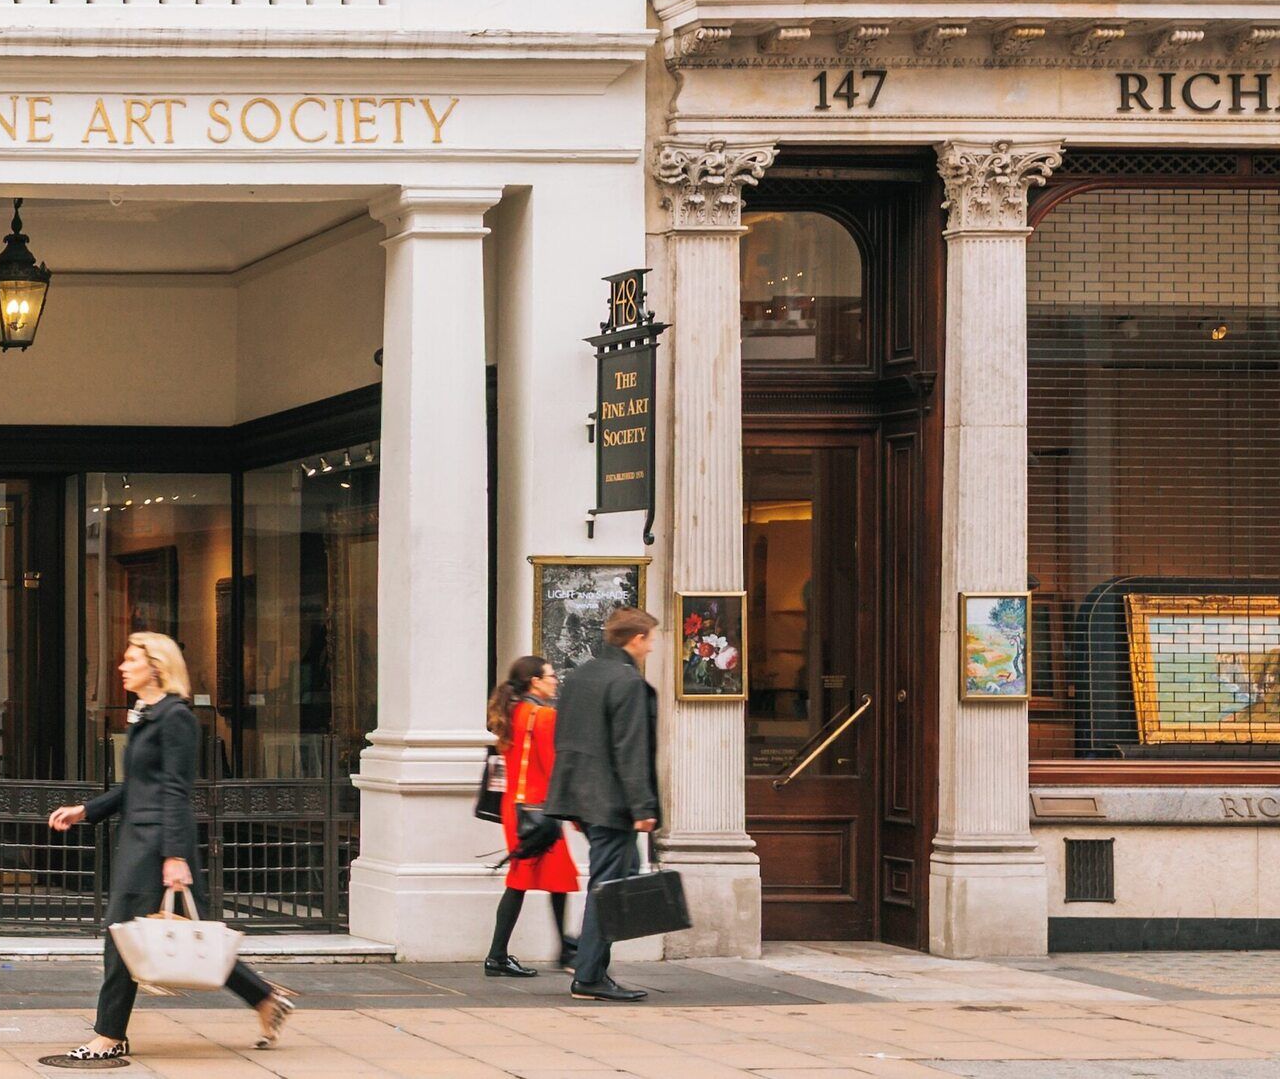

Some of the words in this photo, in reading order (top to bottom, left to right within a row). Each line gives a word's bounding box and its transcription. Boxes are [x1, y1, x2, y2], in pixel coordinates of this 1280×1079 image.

[813, 70, 887, 110] 147
[1115, 73, 1280, 113] RICH
[81, 97, 186, 144] ART
[207, 96, 460, 144] SOCIETY
[613, 278, 636, 328] 148
[614, 372, 637, 390] THE
[602, 401, 625, 419] FINE
[627, 398, 649, 415] ART
[603, 427, 647, 447] SOCIETY
